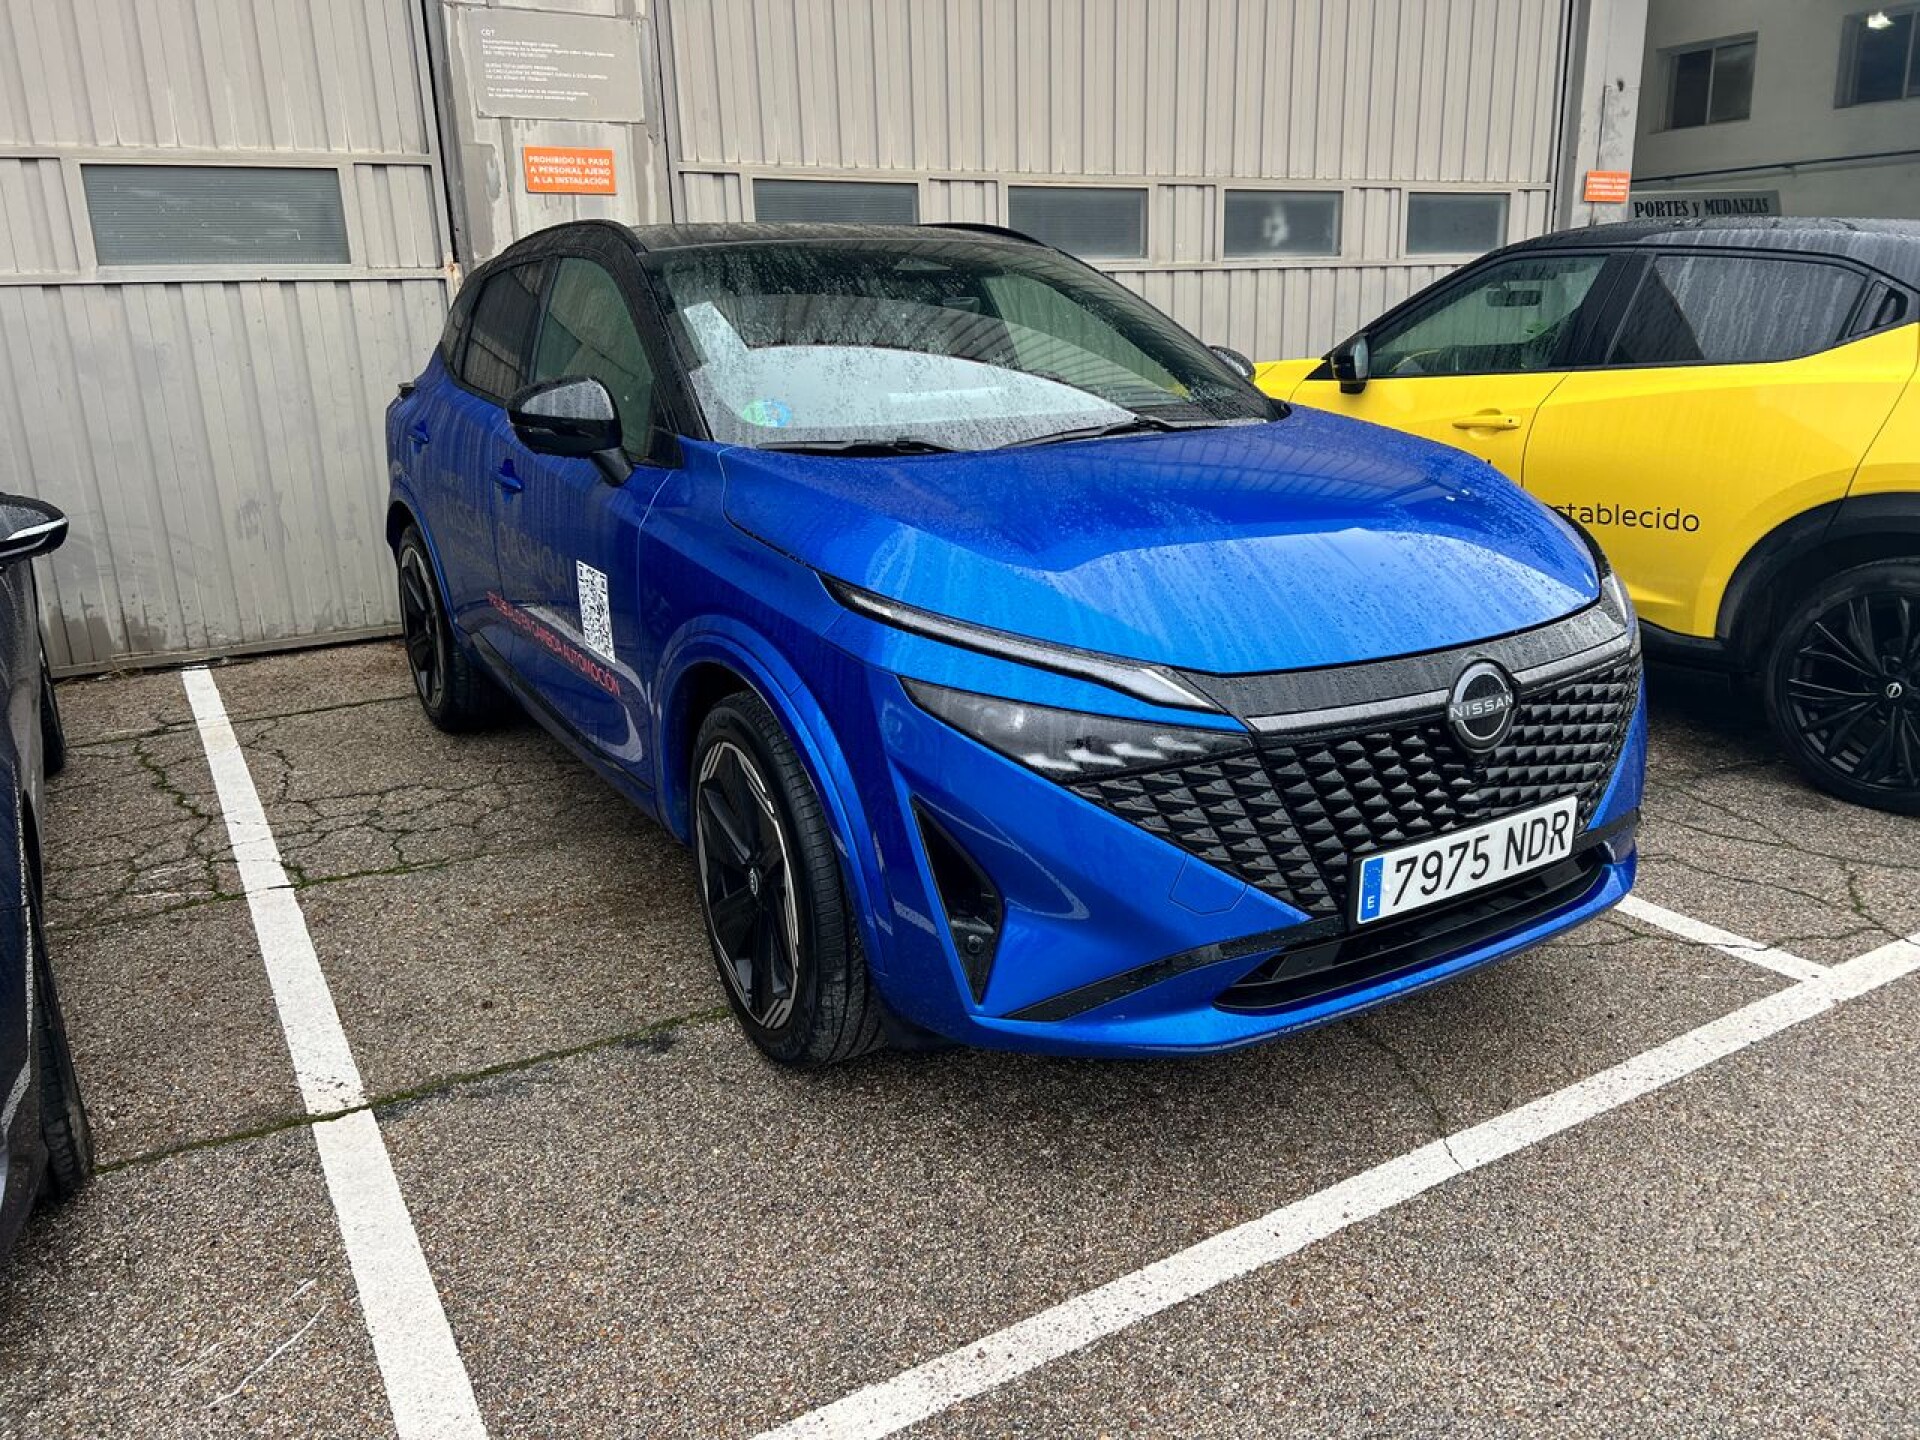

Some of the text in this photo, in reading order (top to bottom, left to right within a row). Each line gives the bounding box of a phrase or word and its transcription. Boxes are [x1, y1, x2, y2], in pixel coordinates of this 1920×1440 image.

[528, 155, 610, 166] PROHIBIDO EL PASO
[530, 166, 611, 176] A PERSONAL AJENO
[533, 176, 540, 184] A
[542, 176, 553, 184] LA
[1634, 201, 1690, 218] PORTES
[1703, 198, 1769, 215] MUDANZAS
[1450, 693, 1513, 718] NISSAN
[1392, 809, 1570, 907] 7975 NDR
[1367, 895, 1375, 910] E
